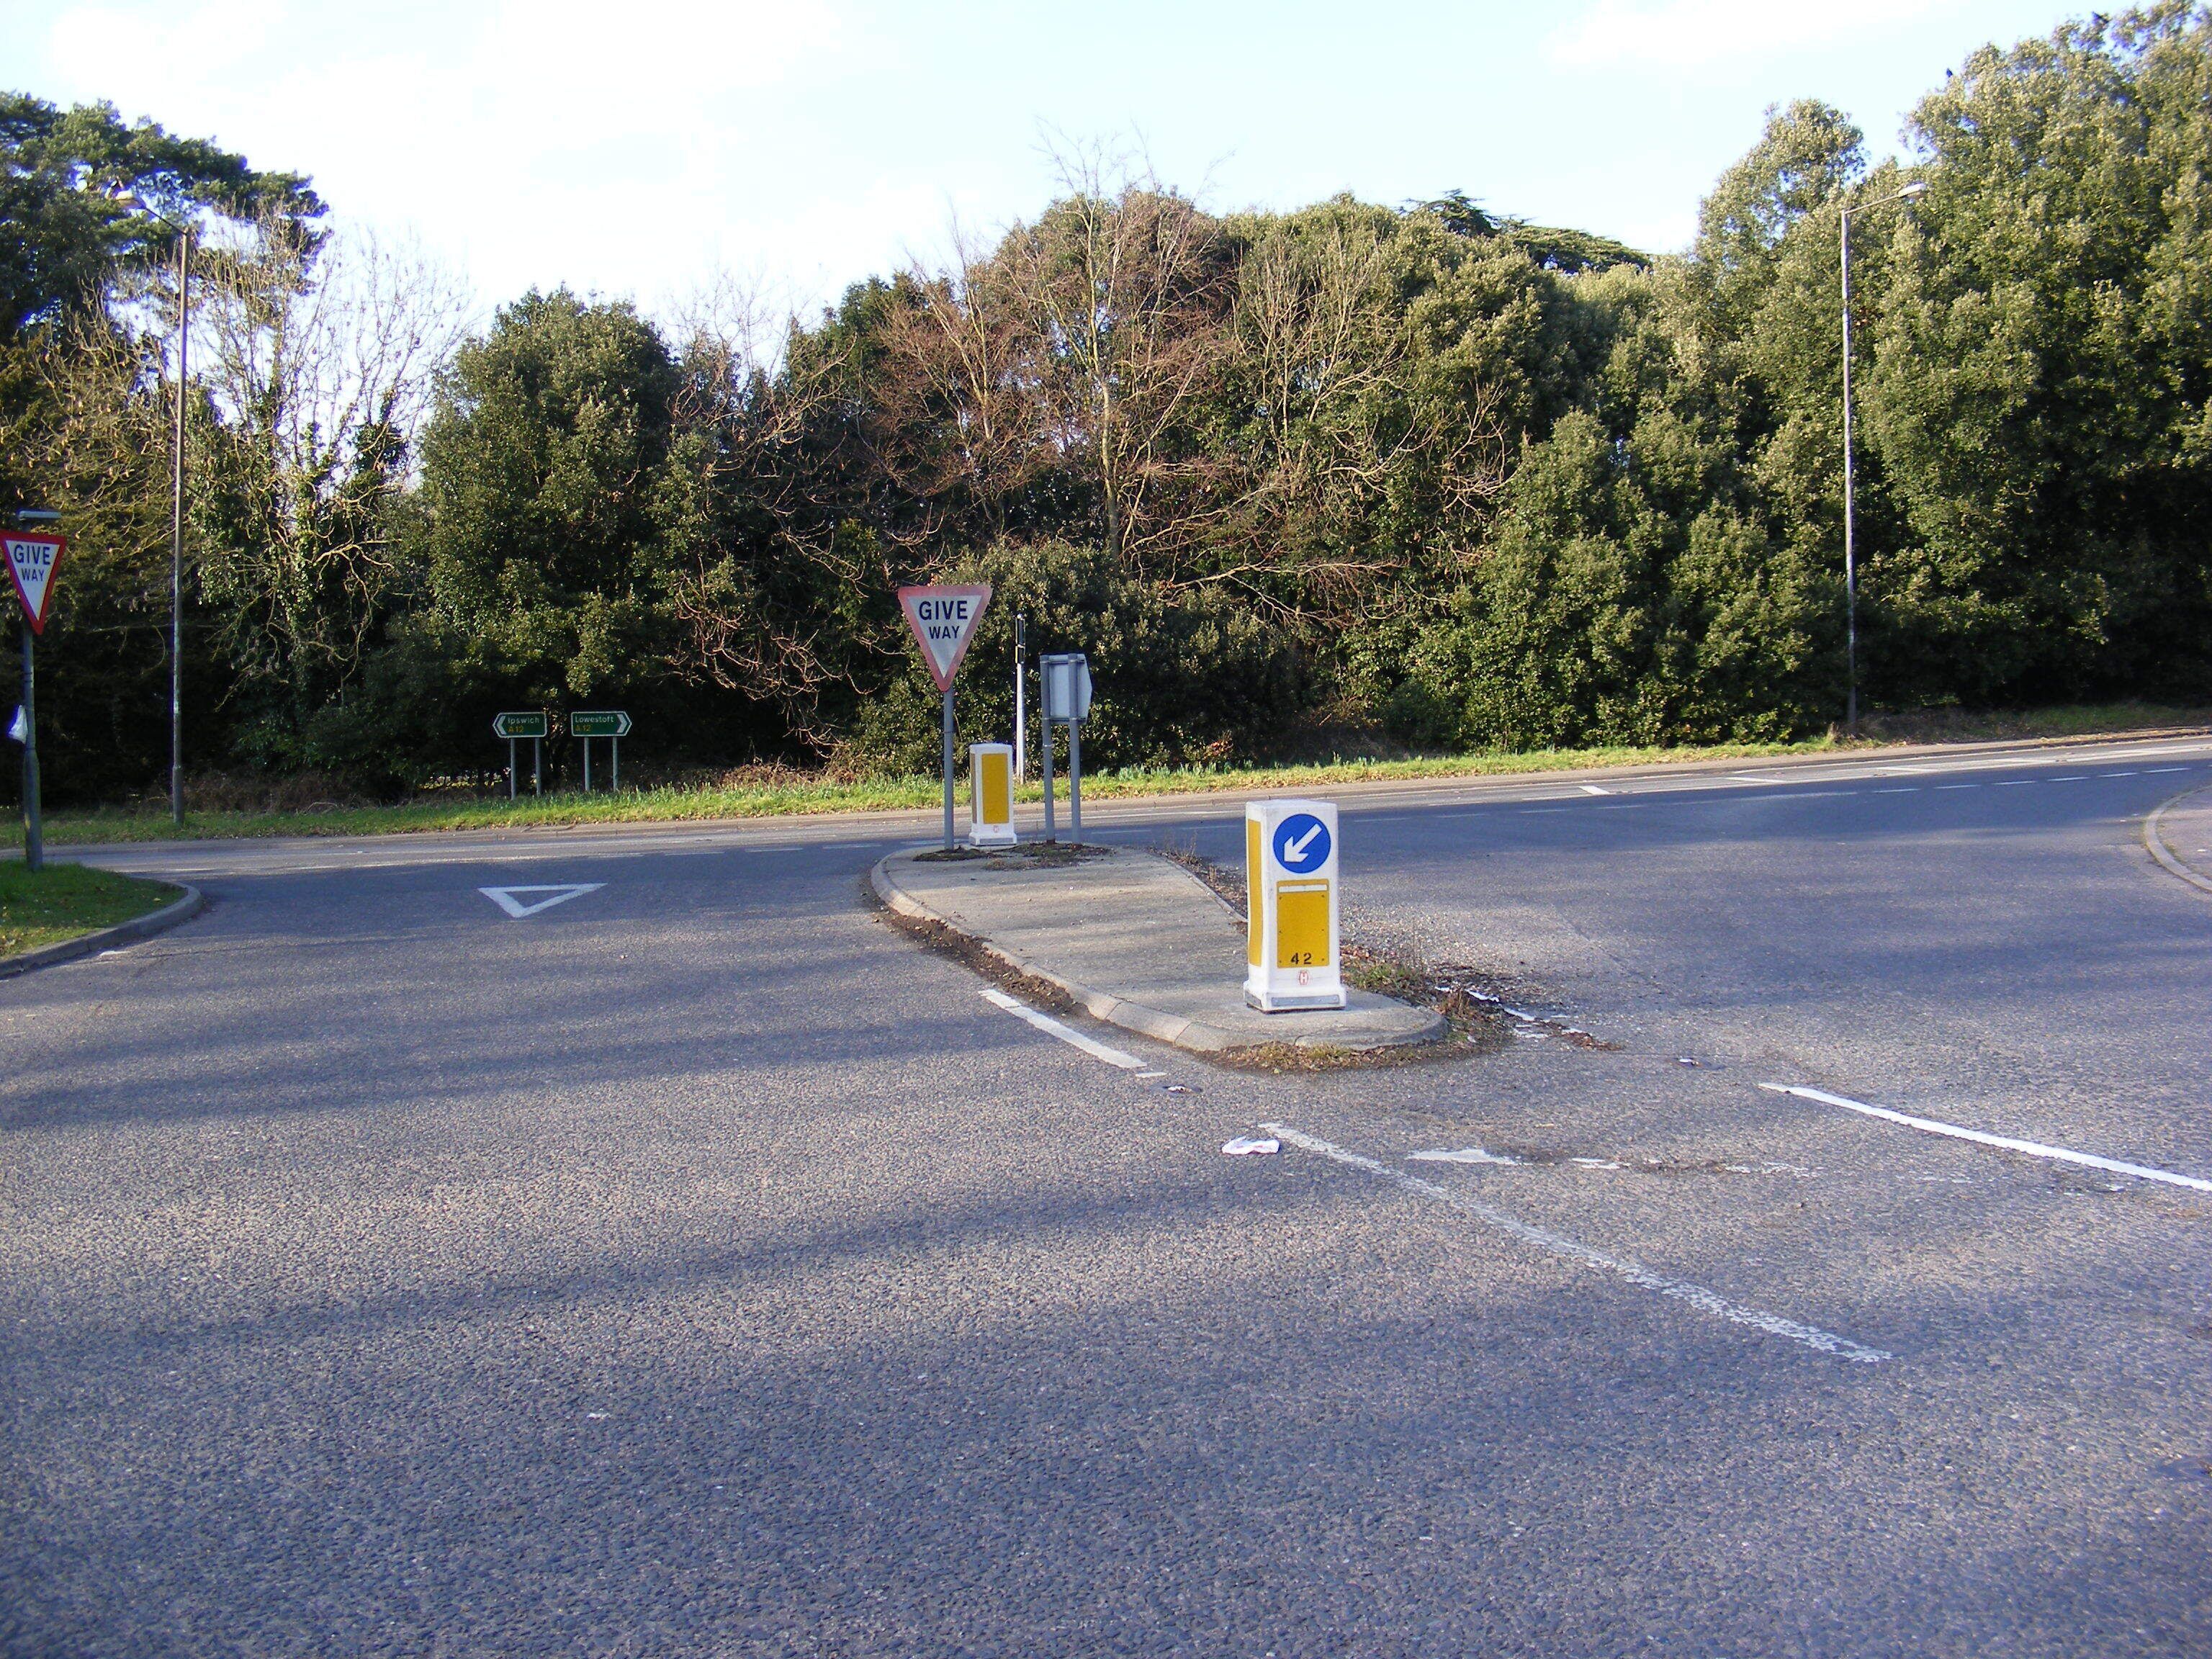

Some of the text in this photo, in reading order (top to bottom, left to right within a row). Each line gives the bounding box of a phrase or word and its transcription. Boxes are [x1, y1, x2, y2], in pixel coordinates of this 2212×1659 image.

[14, 544, 51, 565] GIVE
[21, 567, 45, 582] WAY
[919, 600, 968, 621] GIVE
[929, 625, 960, 639] WAY
[1290, 952, 1312, 965] 42
